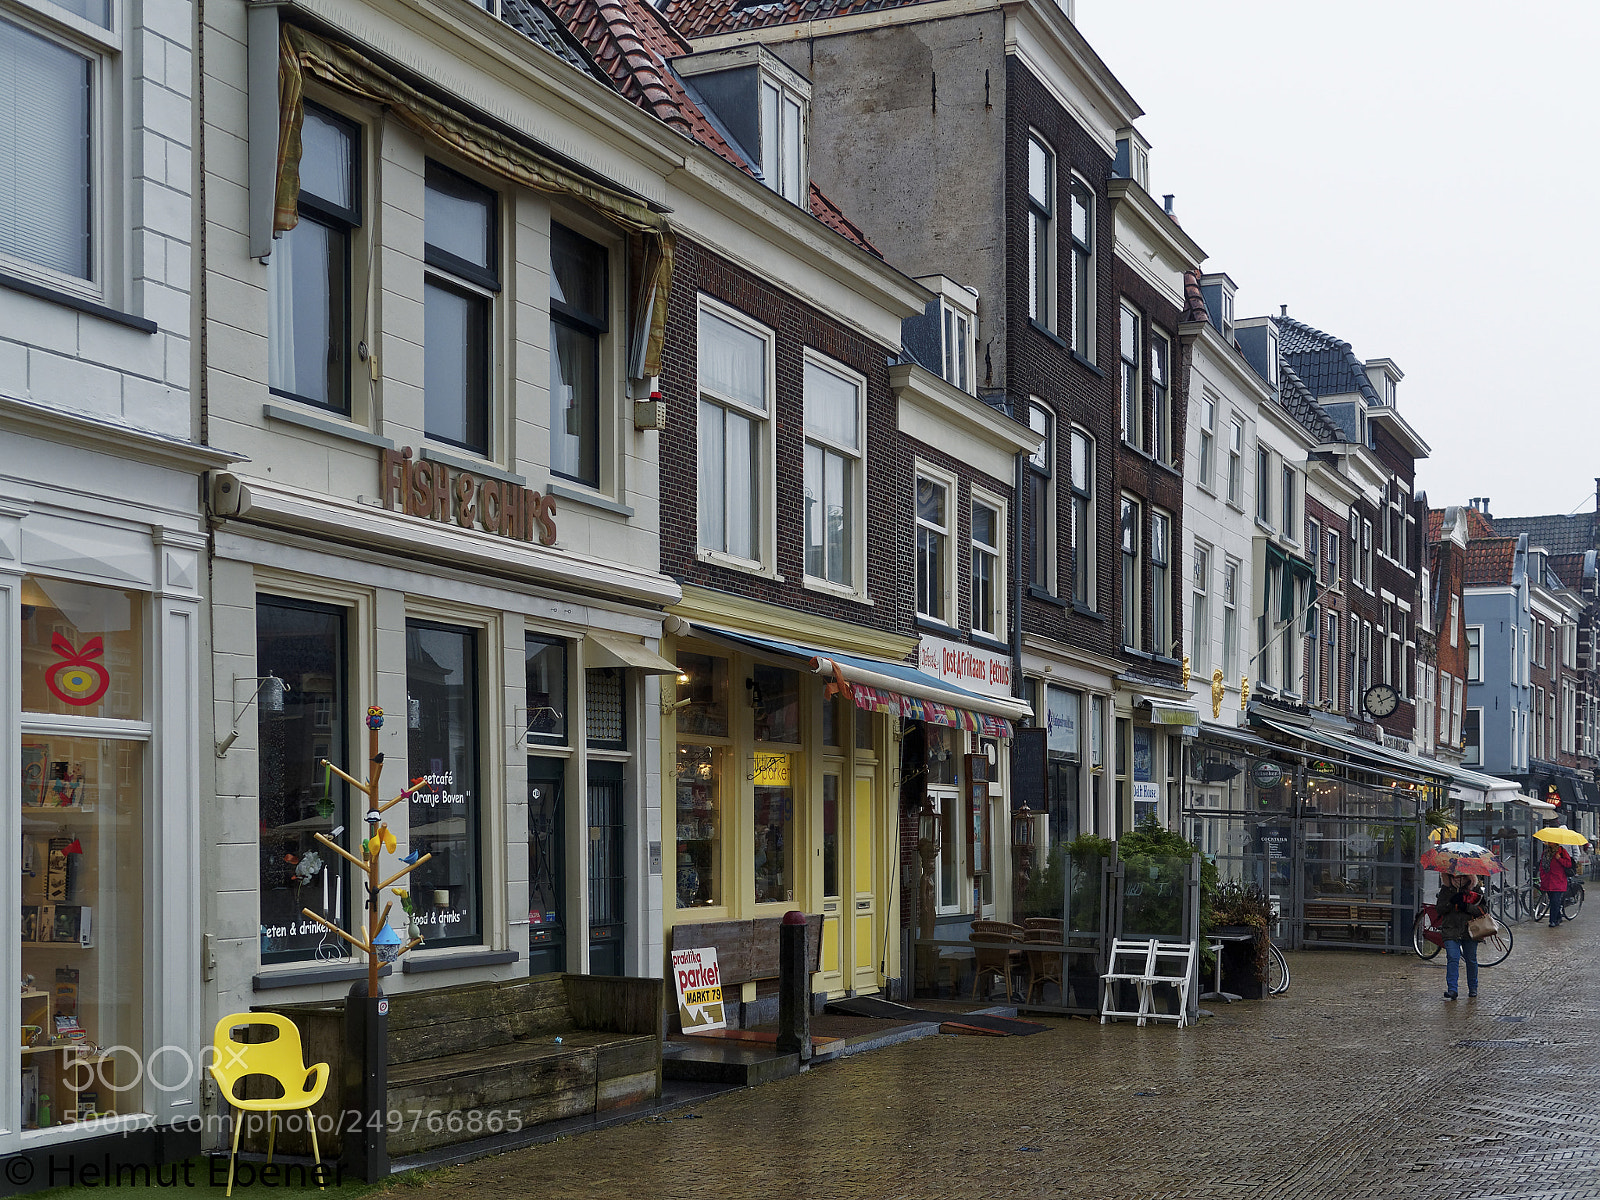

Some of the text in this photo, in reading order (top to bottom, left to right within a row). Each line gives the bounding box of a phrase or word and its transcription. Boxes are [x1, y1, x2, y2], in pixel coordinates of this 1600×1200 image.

[456, 472, 476, 529] &
[412, 790, 440, 808] Oranje
[438, 910, 460, 924] drinks
[266, 924, 287, 938] eten
[289, 922, 297, 936] &
[673, 951, 701, 968] praktika
[678, 962, 719, 994] parket
[686, 989, 721, 1004] MARKT 79
